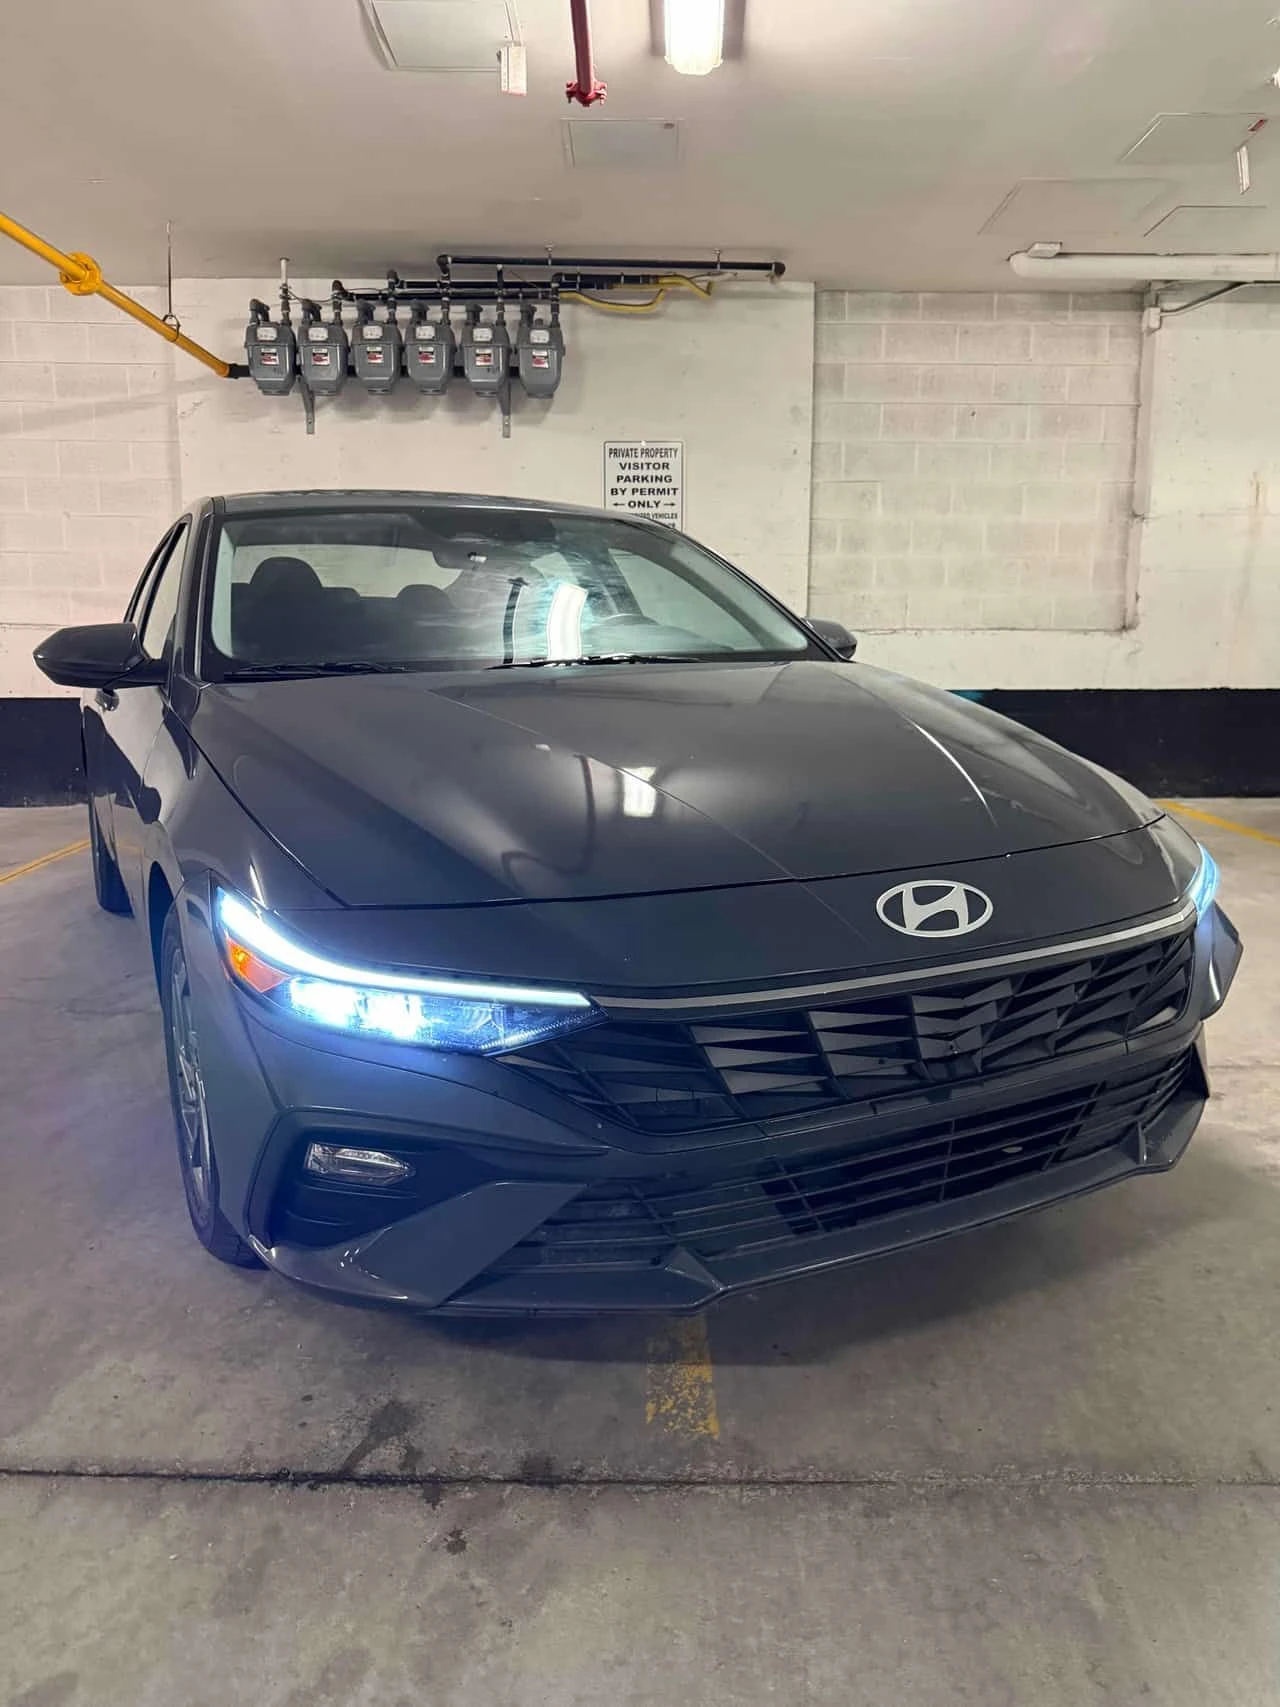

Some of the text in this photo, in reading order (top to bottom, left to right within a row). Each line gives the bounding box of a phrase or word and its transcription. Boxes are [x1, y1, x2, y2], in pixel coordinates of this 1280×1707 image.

[608, 447, 678, 458] PRIVATE PROPERTY
[619, 462, 670, 471] VISITOR
[616, 475, 673, 483] PARKING
[610, 487, 679, 496] BY PERMIT
[627, 500, 661, 508] ONLY
